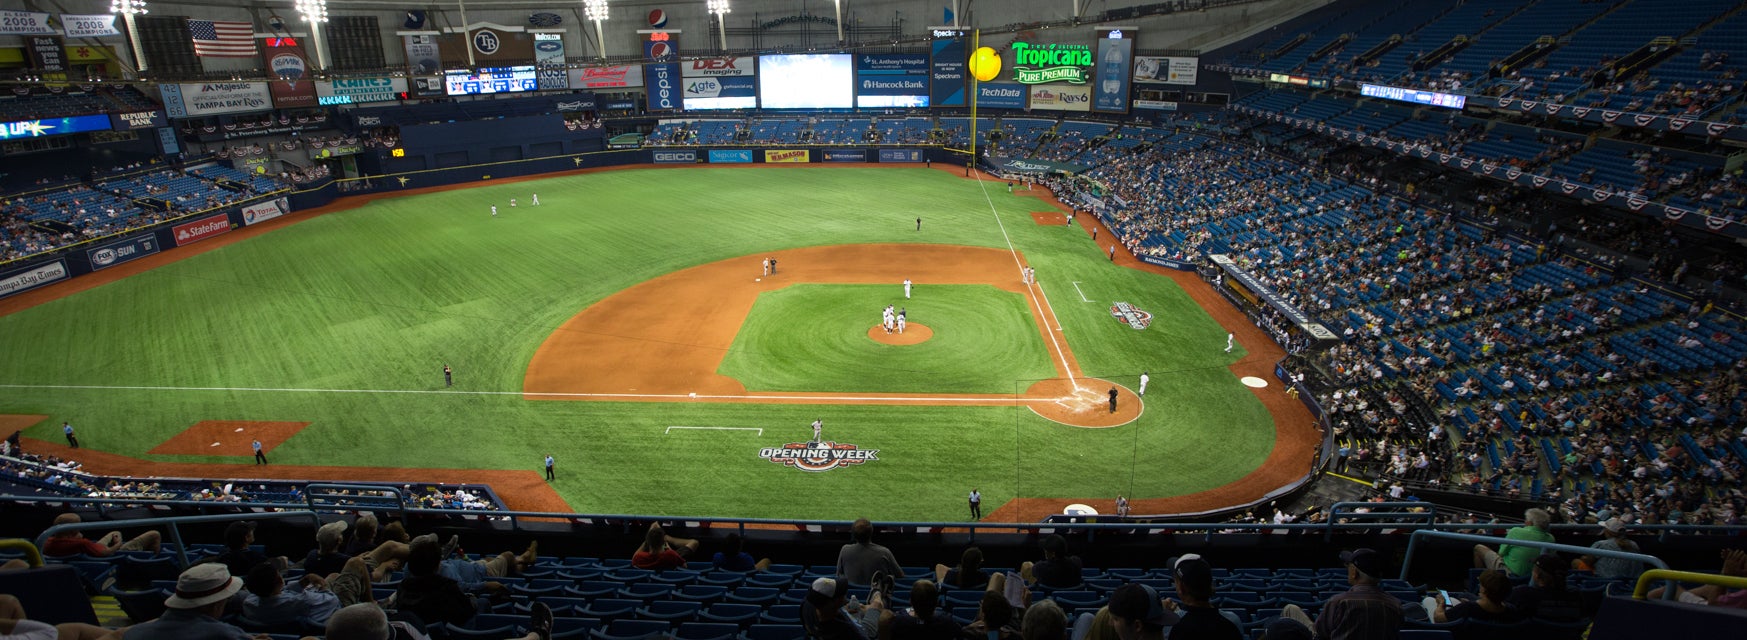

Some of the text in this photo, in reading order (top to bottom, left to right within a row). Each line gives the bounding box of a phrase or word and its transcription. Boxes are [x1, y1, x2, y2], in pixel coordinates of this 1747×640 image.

[4, 17, 37, 26] 2008
[76, 21, 105, 29] 2008
[1012, 42, 1092, 68] Tropicana
[692, 57, 737, 70] DEX
[538, 63, 567, 78] ROSE
[703, 68, 743, 76] imaging
[1019, 69, 1080, 81] PURE PREMIUM
[163, 84, 176, 93] 42
[214, 82, 251, 93] Majestic
[655, 66, 673, 108] pepsi
[698, 80, 716, 92] gte
[872, 80, 924, 88] Hancock Bank
[167, 95, 178, 105] 12
[1081, 93, 1089, 103] 6
[194, 101, 226, 110] TAMPA
[226, 99, 243, 108] BAY
[120, 111, 158, 121] REPUBLIC
[130, 118, 152, 126] BANK
[655, 153, 695, 161] GEICO
[97, 244, 136, 259] FOX SUN
[0, 268, 62, 291] ampa Bay Times
[760, 448, 876, 460] OPENING WEEK
